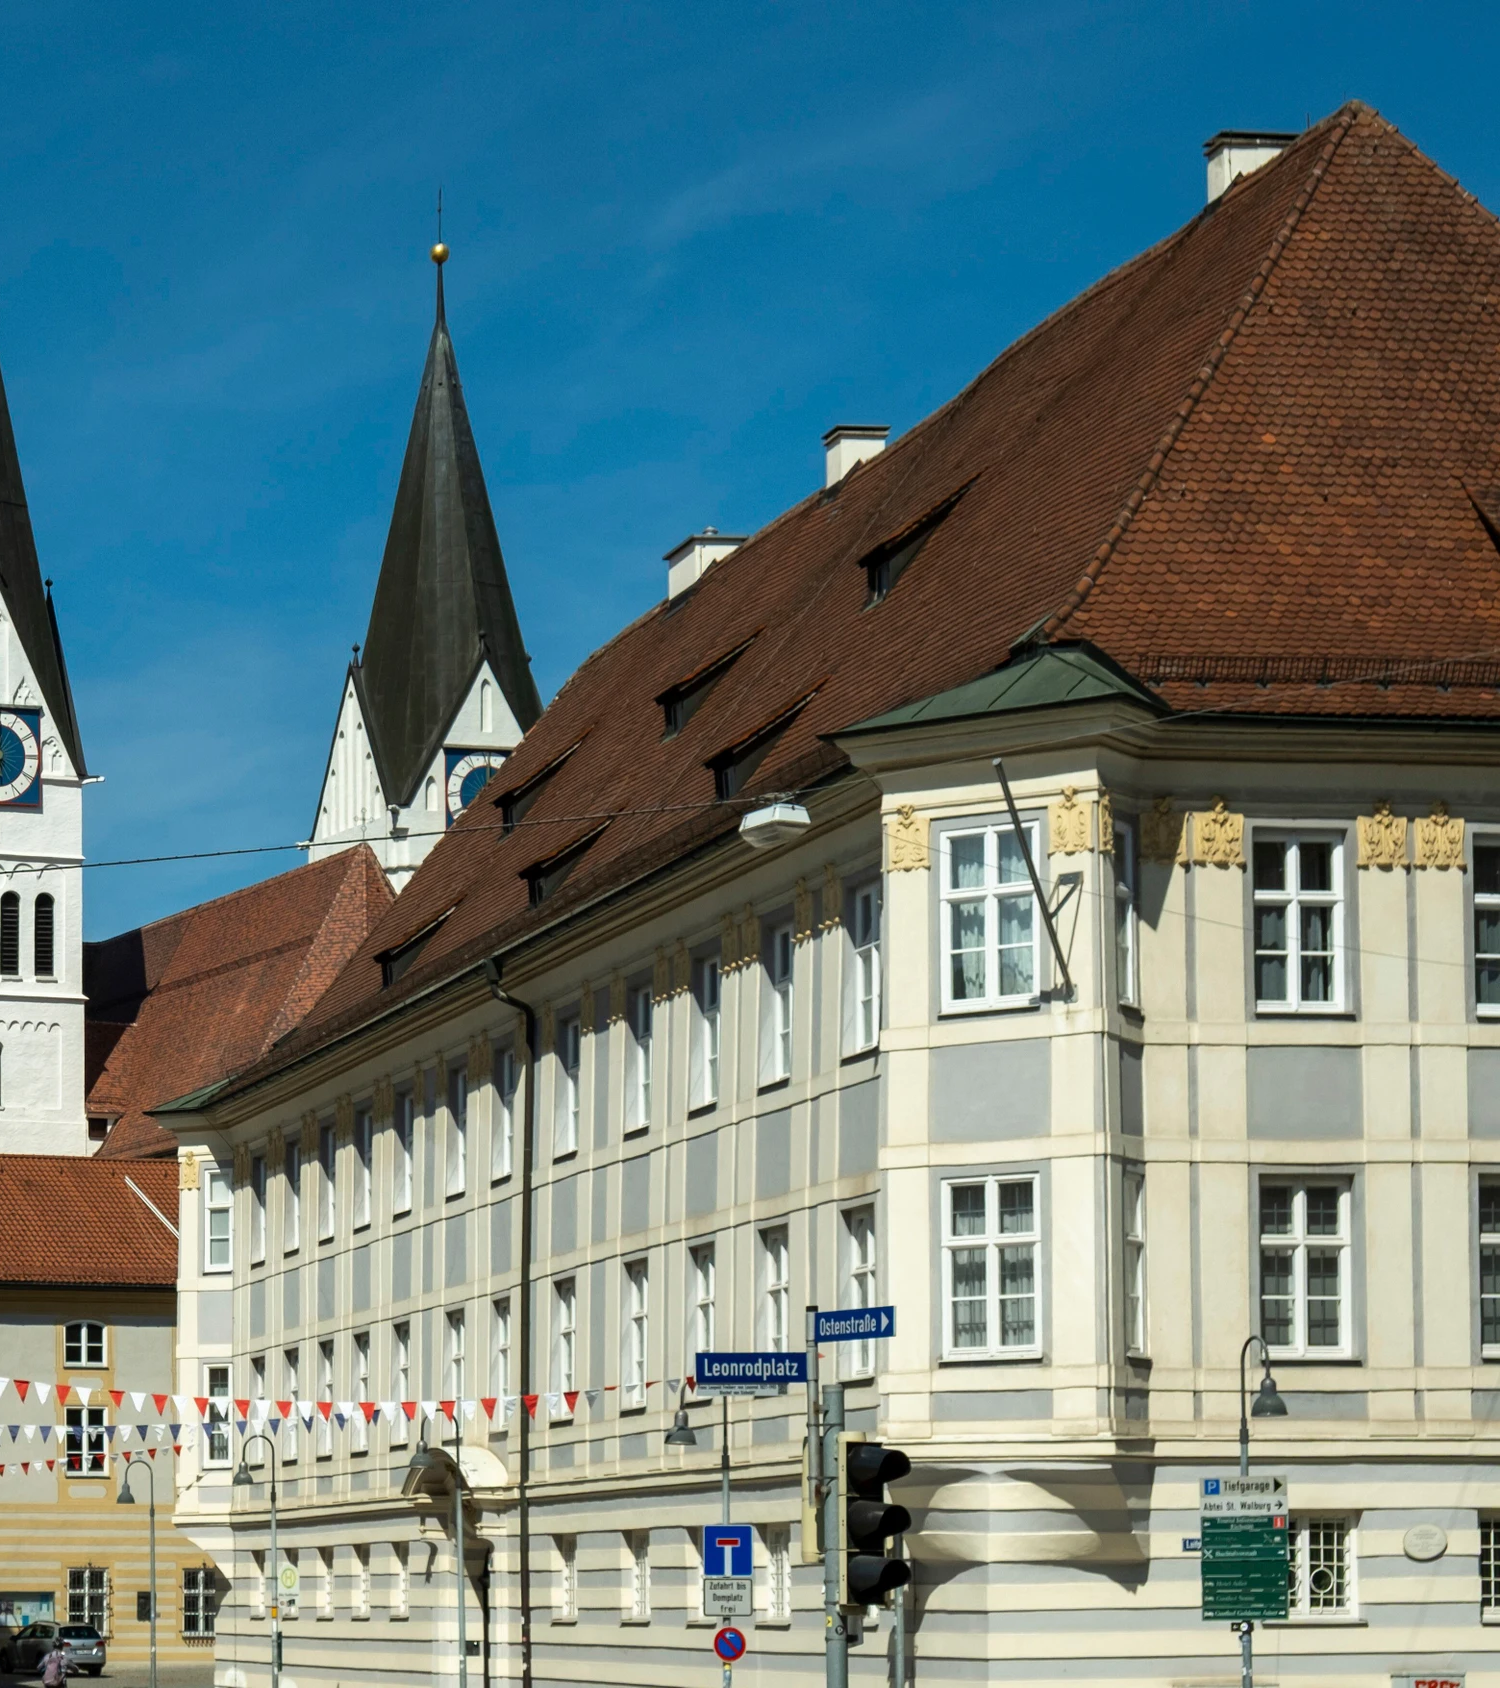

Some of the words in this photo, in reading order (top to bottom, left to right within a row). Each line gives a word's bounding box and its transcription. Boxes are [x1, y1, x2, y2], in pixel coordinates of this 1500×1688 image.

[819, 1313, 877, 1336] Ostenstraße
[704, 1358, 799, 1381] Leonrodplatz
[1224, 1481, 1270, 1493] Tiefgarage
[1203, 1503, 1223, 1511] Abtei
[1240, 1501, 1271, 1512] Walburg
[709, 1582, 733, 1591] Zufahrt
[737, 1582, 747, 1590] bis
[712, 1593, 743, 1603] Domplatz
[720, 1604, 736, 1613] frei
